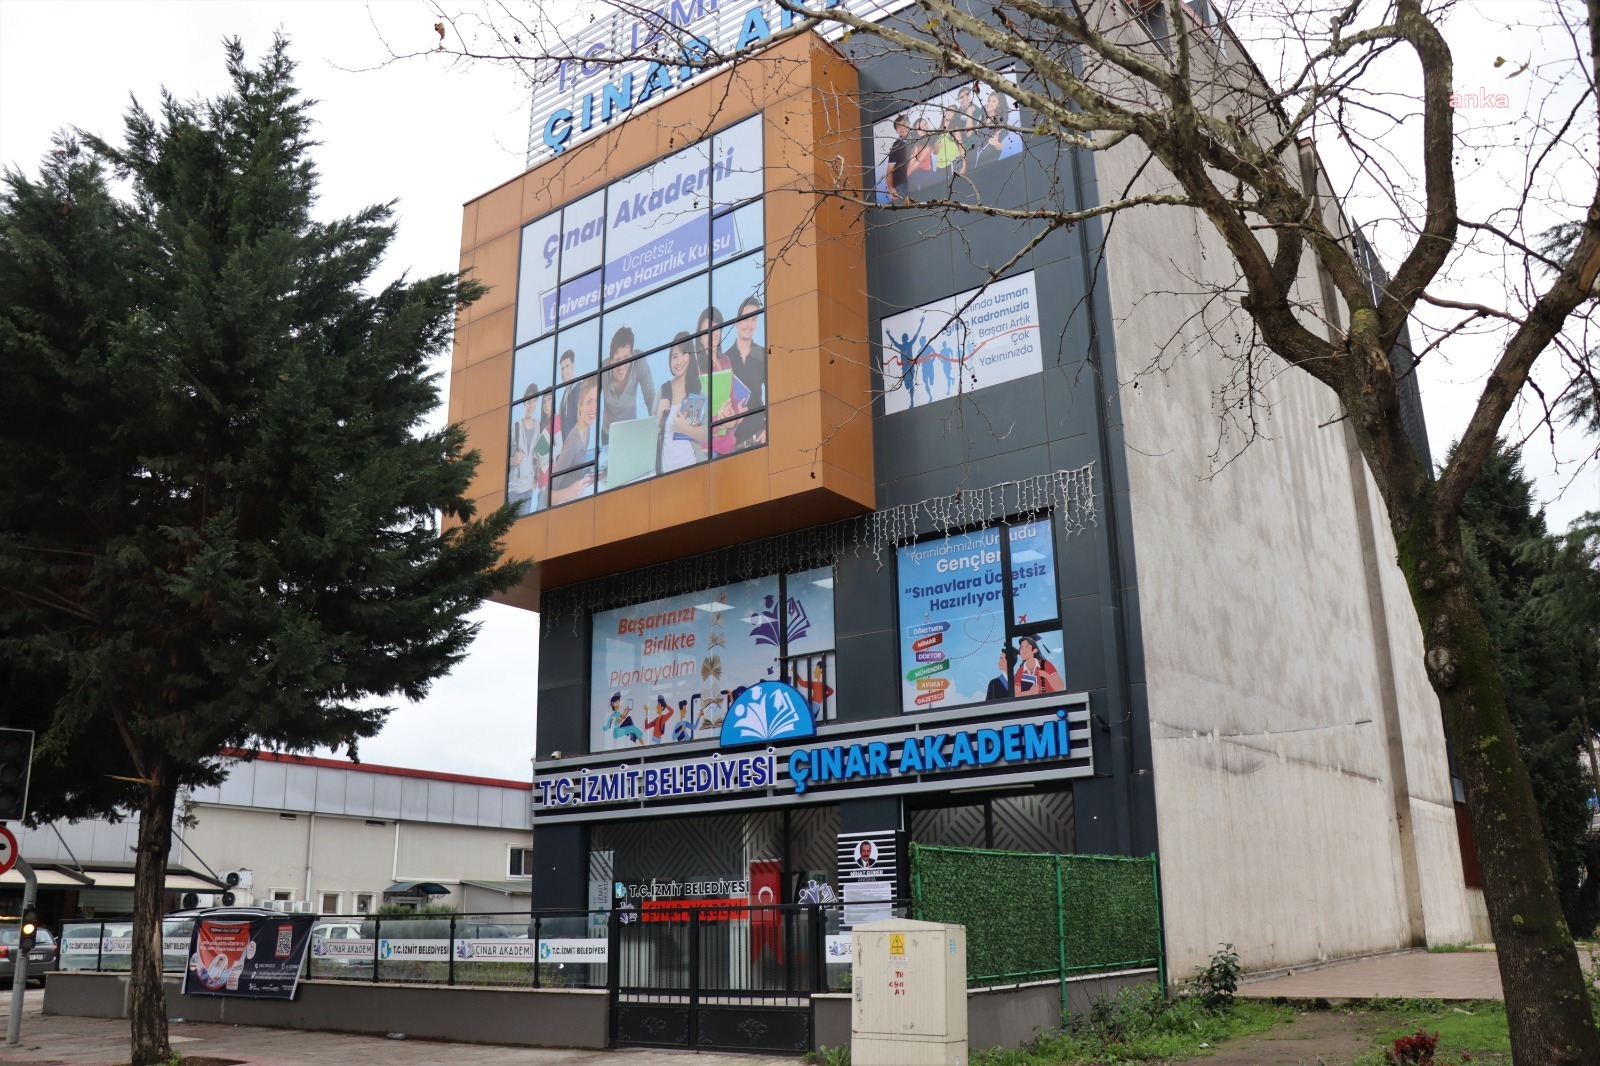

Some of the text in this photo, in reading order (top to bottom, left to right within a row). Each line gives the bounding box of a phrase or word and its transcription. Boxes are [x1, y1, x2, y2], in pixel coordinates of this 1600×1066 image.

[543, 35, 712, 157] ÇINAR
[613, 146, 735, 229] Akademi
[623, 238, 675, 272] Ücretsiz
[634, 250, 685, 286] Hazırlık
[688, 234, 730, 262] Kusu
[994, 287, 1029, 304] Uzman
[971, 301, 1030, 326] Kadromuzla
[979, 314, 1031, 338] Başarı Artık
[1010, 330, 1030, 345] Çok
[979, 344, 1033, 367] Yakınınızda
[985, 562, 1046, 585] Ücetsiz
[618, 606, 696, 636] Başarınızı
[913, 624, 944, 635] ÖĞRETMEN
[643, 631, 696, 656] Birlikte
[917, 637, 936, 648] MİMAR
[918, 652, 942, 660] DOKTOR
[610, 659, 696, 688] Planlayalım
[914, 664, 944, 678] MÜHENDİS
[921, 680, 944, 688] AVUKAT
[917, 693, 944, 705] GAZETECİ
[788, 708, 1072, 795] ÇINAR AKADEMİ
[644, 746, 778, 798] BELEDİYESİ
[684, 877, 750, 896] BELEDİYESİ
[328, 944, 346, 954] ÇINAR
[418, 943, 450, 955] BELEDİYESİ
[475, 945, 497, 956] ÇINAR
[576, 945, 606, 955] BELEDİYESİ
